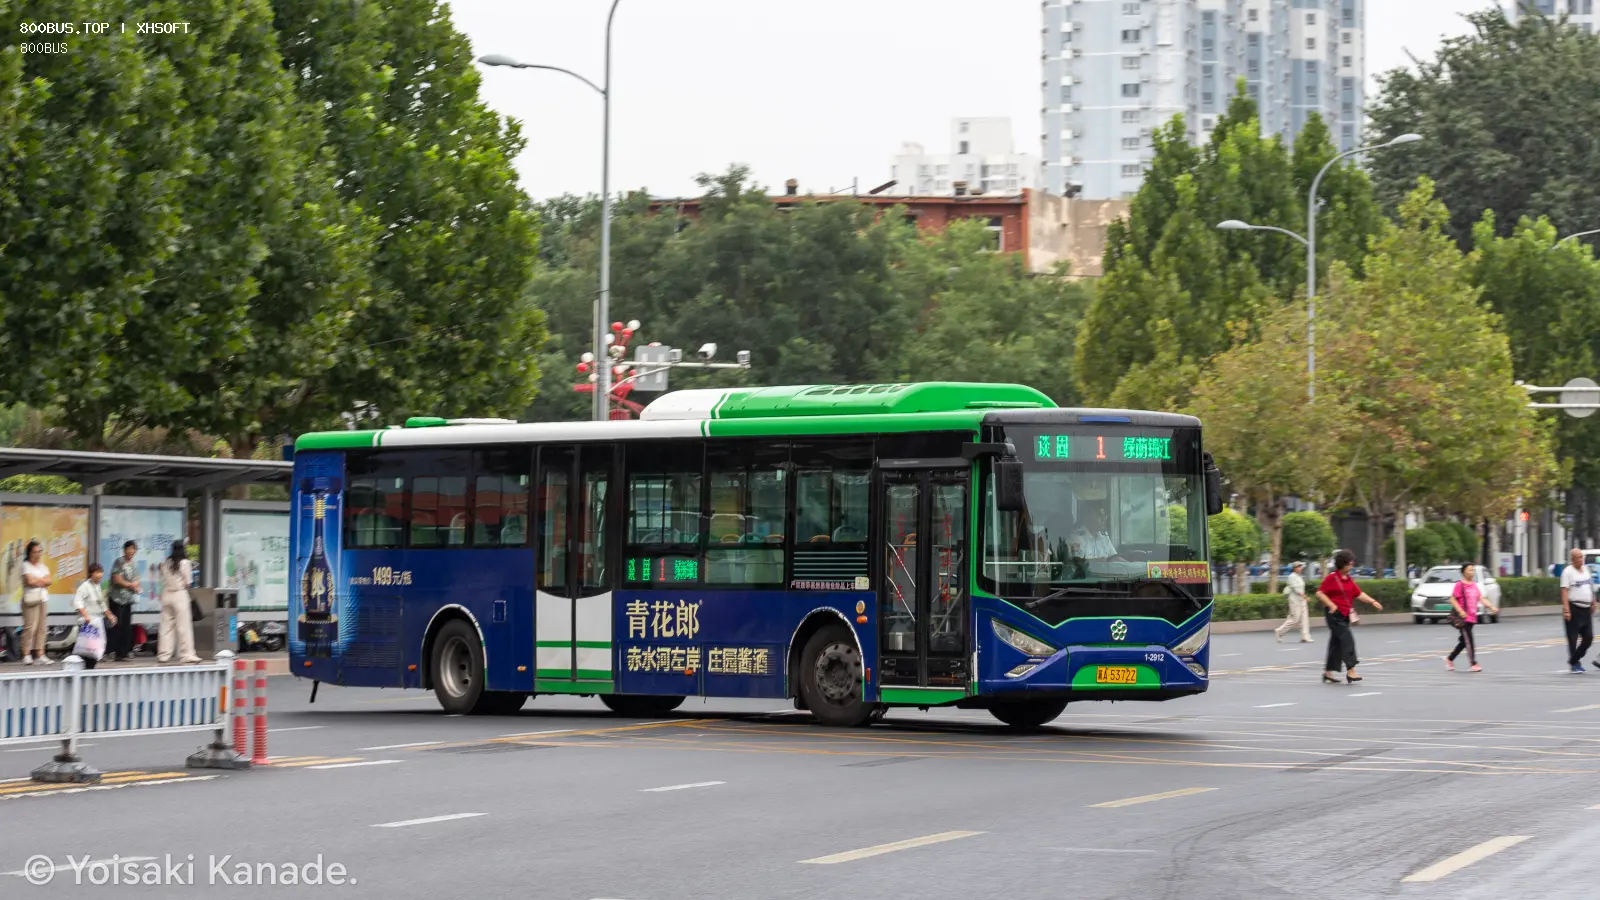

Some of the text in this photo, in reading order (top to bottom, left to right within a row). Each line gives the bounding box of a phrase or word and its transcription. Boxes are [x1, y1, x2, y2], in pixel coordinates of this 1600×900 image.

[1096, 436, 1106, 459] 1
[659, 558, 666, 581] 1
[625, 599, 700, 639] 青花郎
[627, 646, 769, 674] 赤水河左岸 庄园酱酒
[1144, 653, 1165, 662] 1-2912
